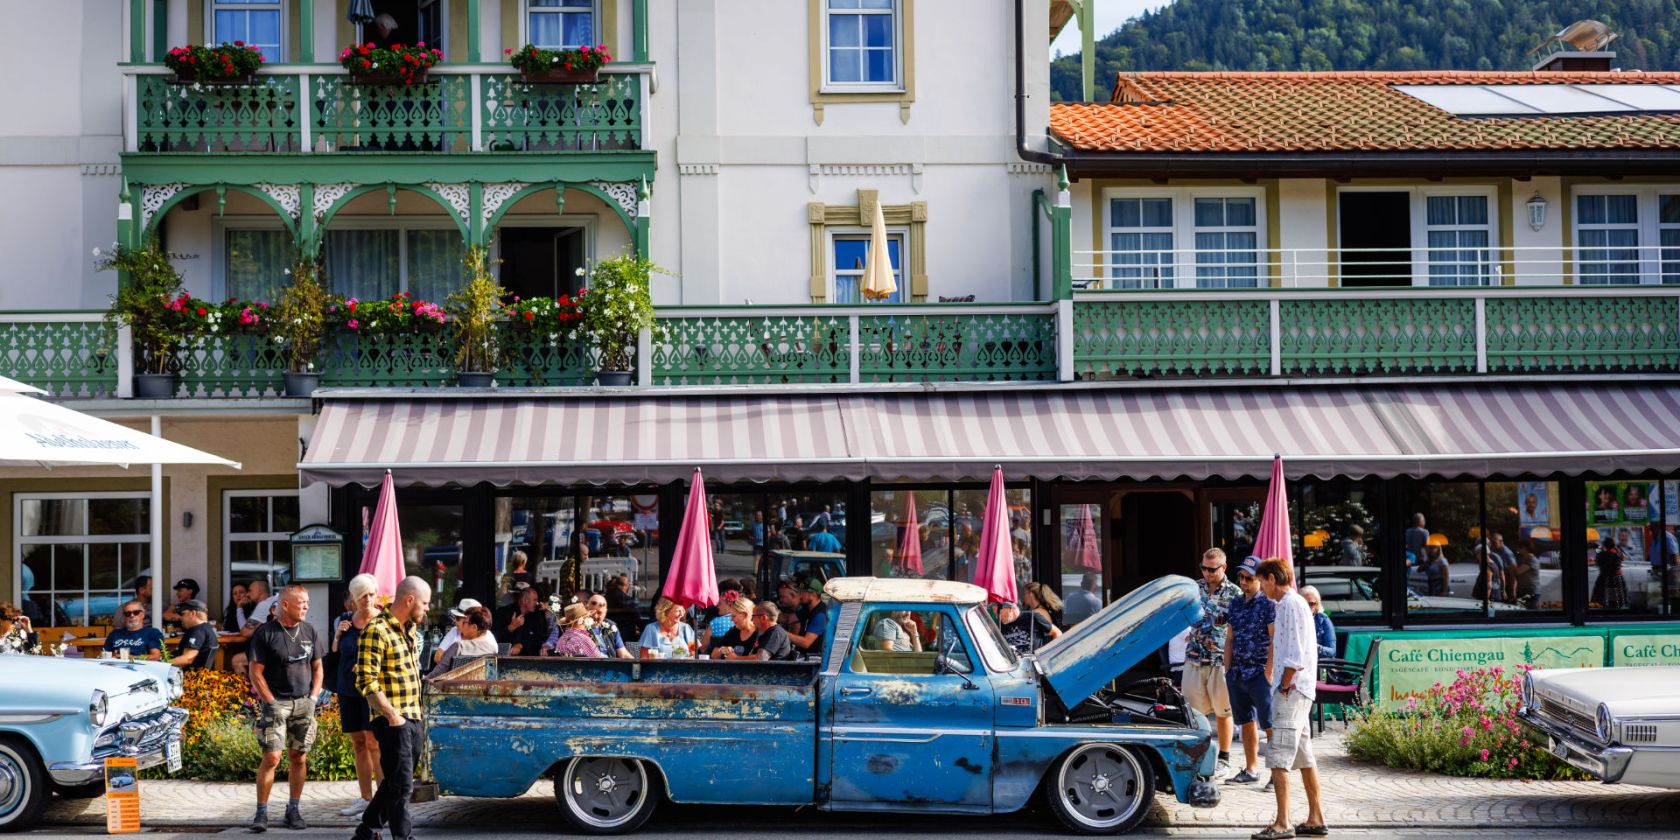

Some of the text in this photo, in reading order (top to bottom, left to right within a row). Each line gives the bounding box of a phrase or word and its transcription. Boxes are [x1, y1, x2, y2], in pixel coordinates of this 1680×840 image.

[1388, 648, 1505, 665] Café Chiemgau
[1623, 644, 1657, 658] Café
